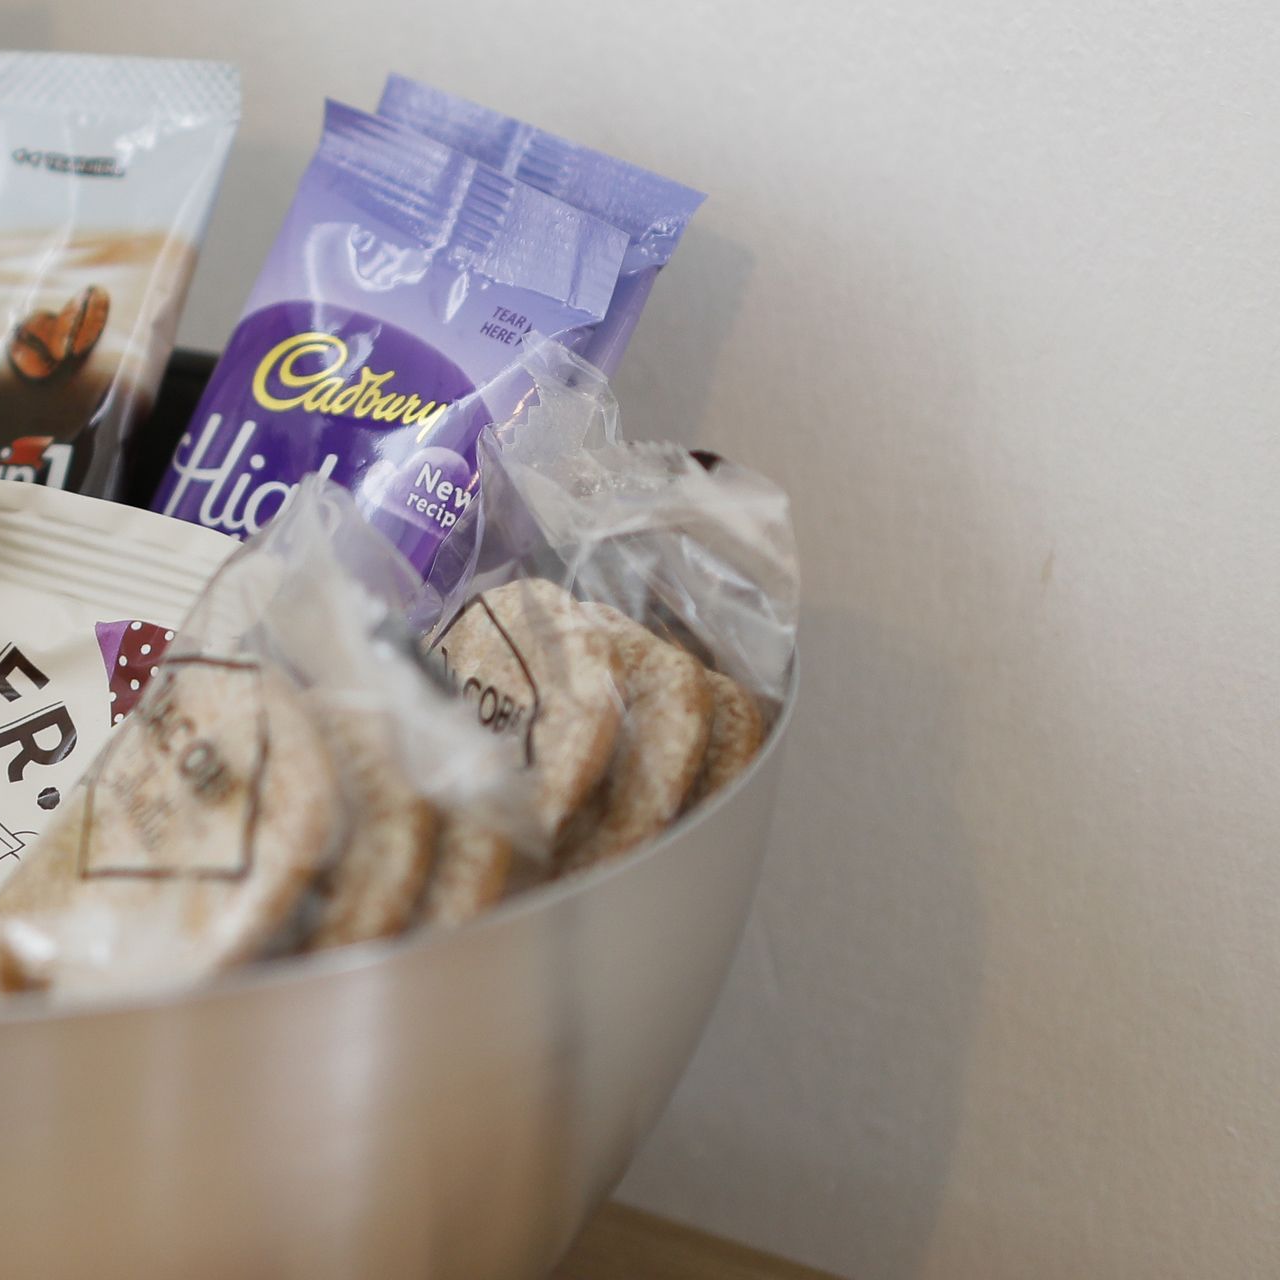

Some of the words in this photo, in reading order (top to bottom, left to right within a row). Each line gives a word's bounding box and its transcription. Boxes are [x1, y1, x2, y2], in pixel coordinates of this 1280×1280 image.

[492, 305, 528, 329] TEAR
[480, 321, 518, 345] HERE
[251, 330, 449, 444] Cadbury
